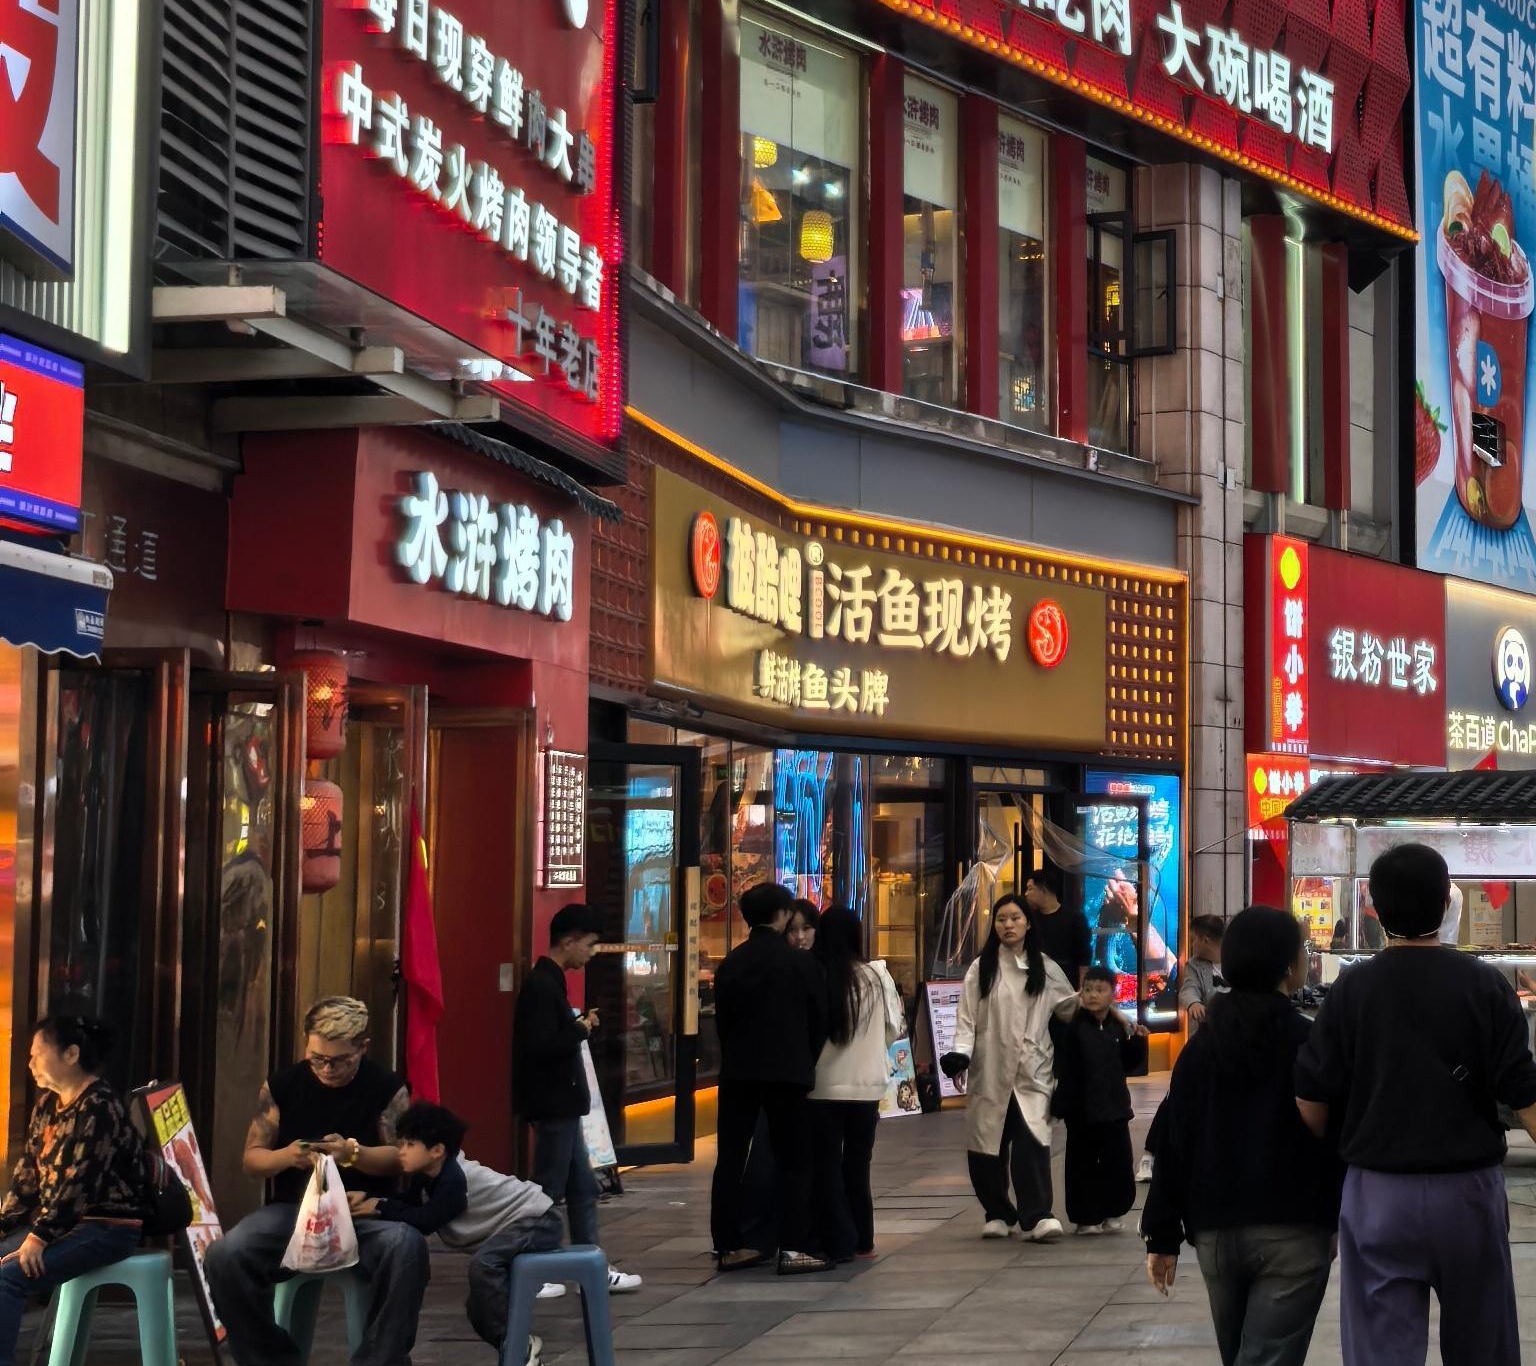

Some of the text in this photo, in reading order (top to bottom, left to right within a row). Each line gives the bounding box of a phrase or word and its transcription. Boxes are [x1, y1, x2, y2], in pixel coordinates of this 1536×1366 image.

[339, 62, 603, 313] 中式炭火烤肉领导者
[506, 290, 601, 403] 十年老店
[398, 470, 576, 623] 水浒烤肉
[825, 561, 1013, 662] 活鱼现烤
[1447, 711, 1495, 749] 茶百道
